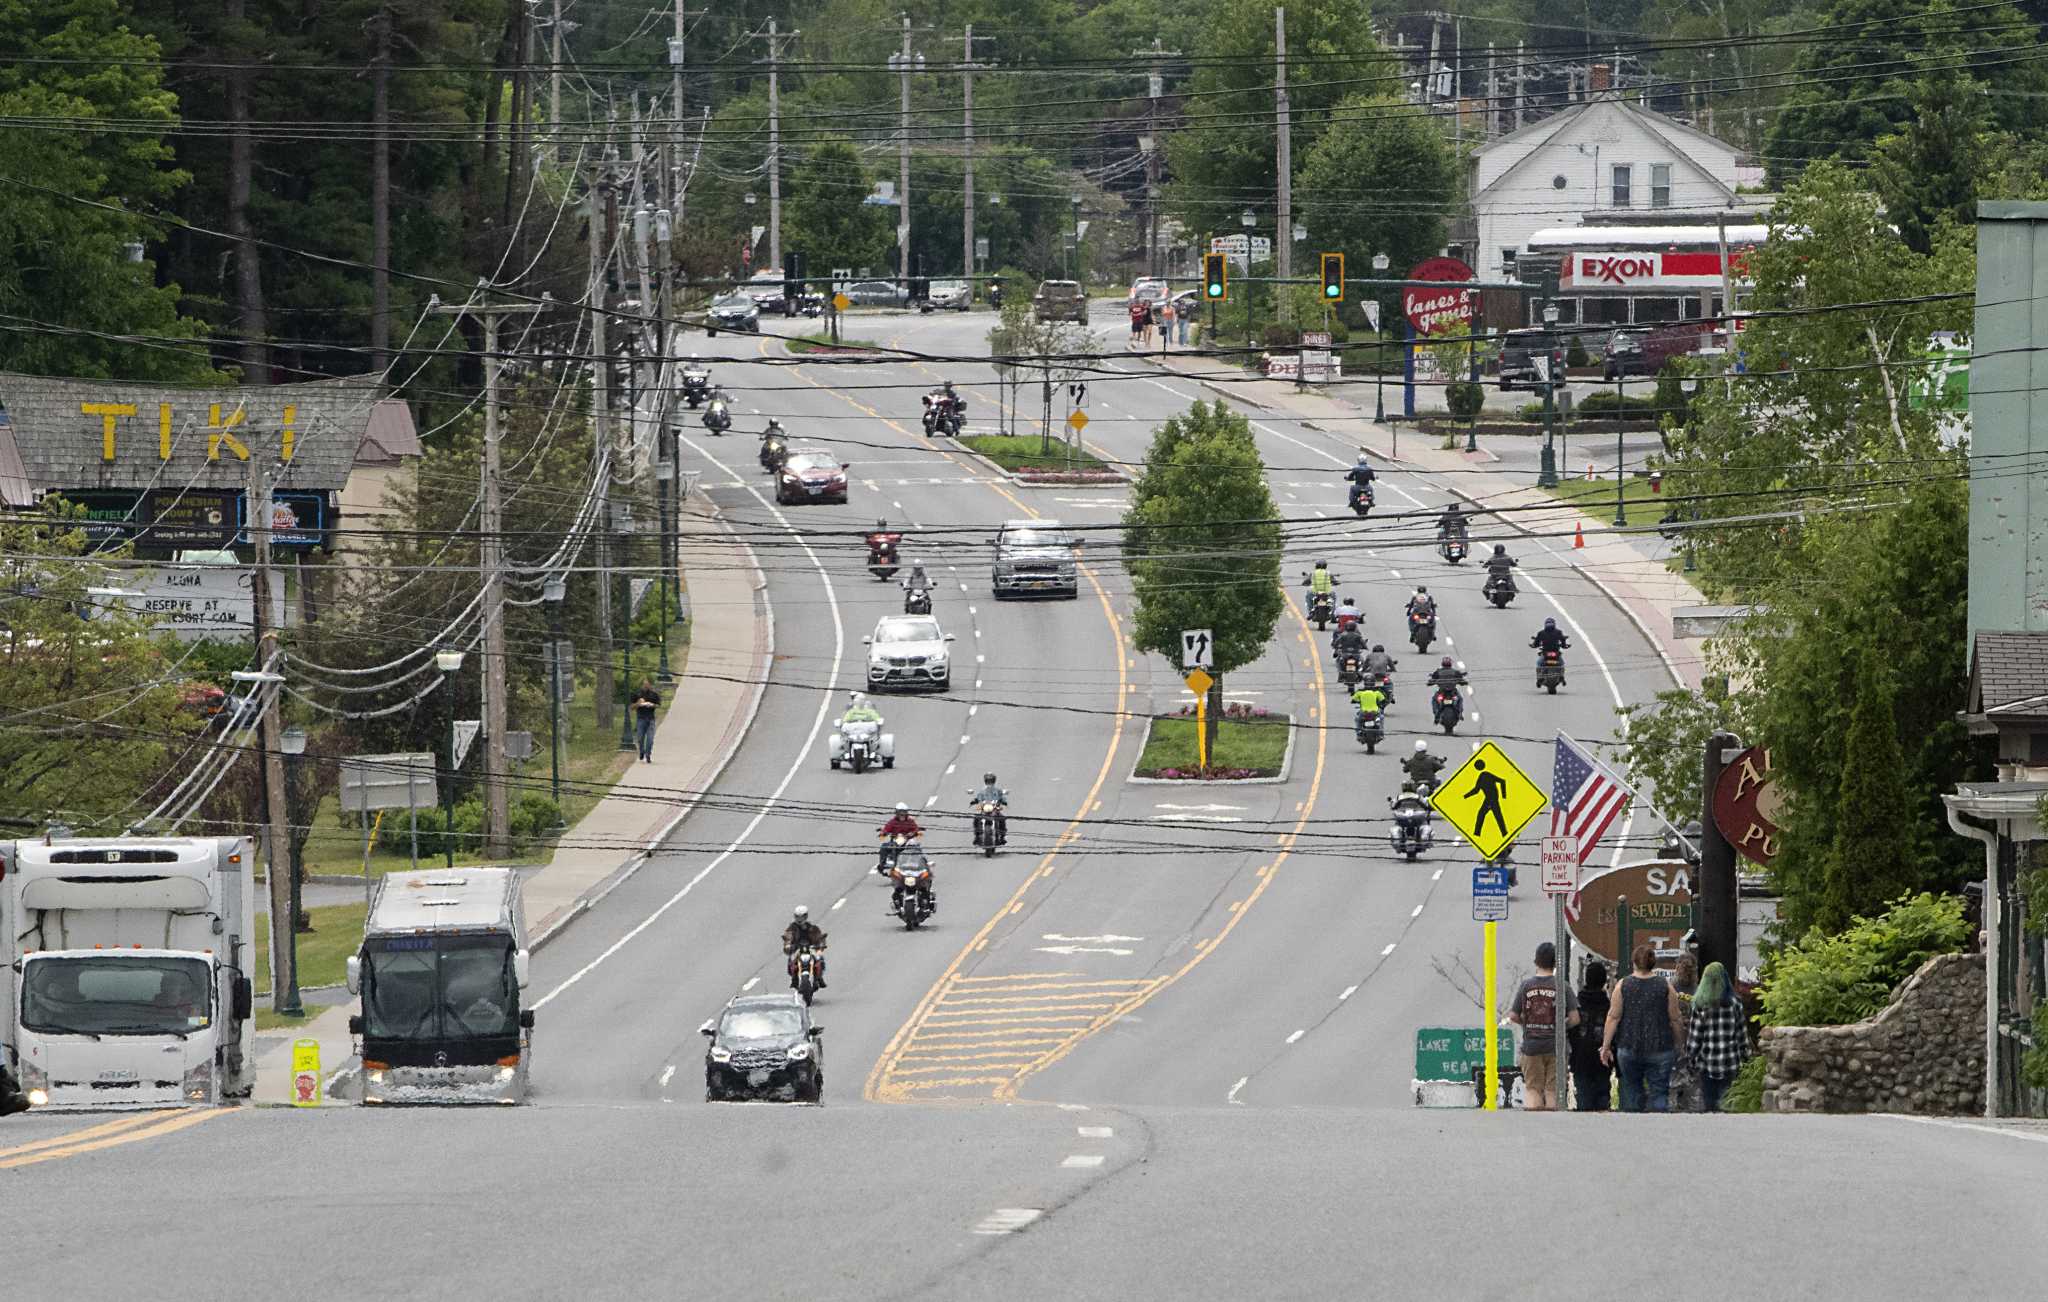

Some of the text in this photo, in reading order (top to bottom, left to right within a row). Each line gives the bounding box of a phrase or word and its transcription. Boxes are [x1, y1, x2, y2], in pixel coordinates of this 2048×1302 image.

[1582, 256, 1653, 284] EXXON
[1407, 291, 1469, 315] lanes &
[1420, 304, 1473, 332] game
[81, 402, 296, 460] TIKI
[166, 576, 202, 587] ALOHA
[145, 600, 218, 611] RESERVE AT
[1552, 841, 1567, 851] NO
[1738, 823, 1781, 857] PU
[1543, 853, 1576, 863] PARKING
[1631, 904, 1686, 918] SEWELL
[1419, 1039, 1450, 1052] LAKE
